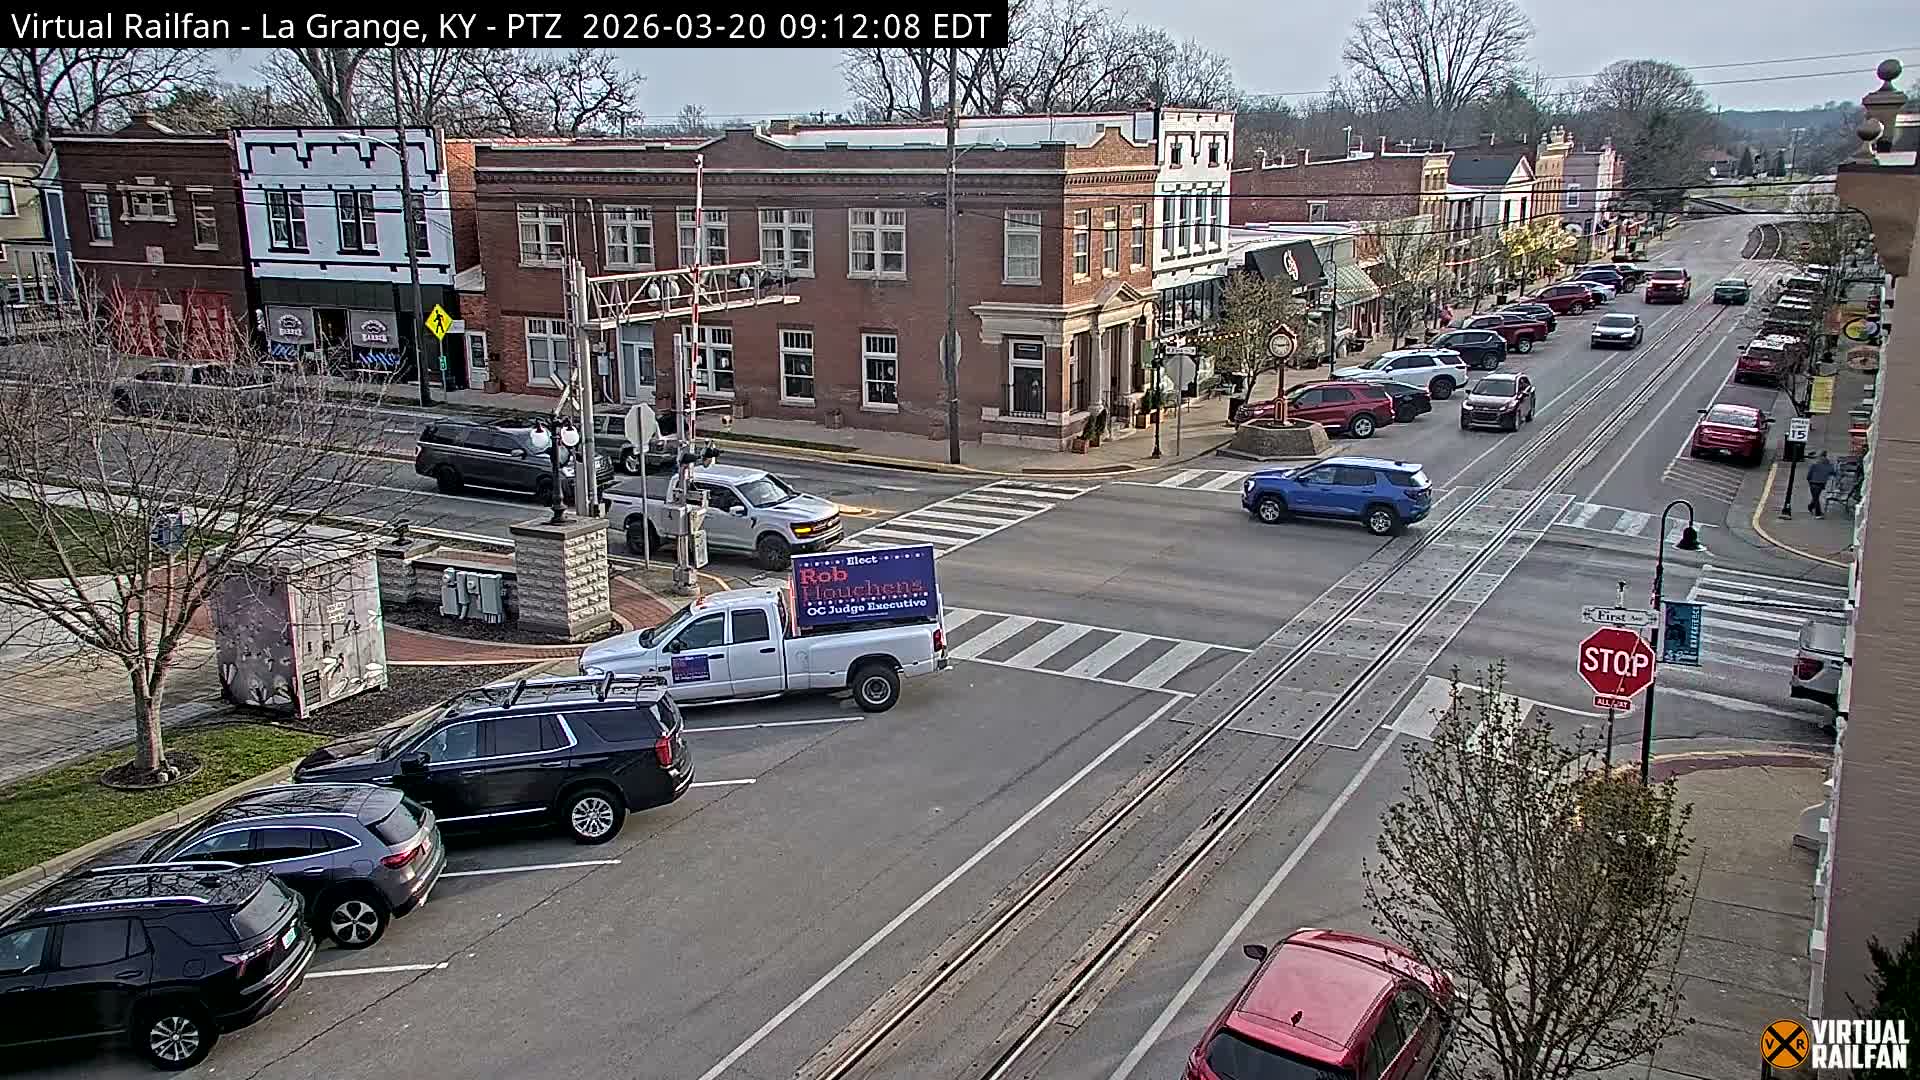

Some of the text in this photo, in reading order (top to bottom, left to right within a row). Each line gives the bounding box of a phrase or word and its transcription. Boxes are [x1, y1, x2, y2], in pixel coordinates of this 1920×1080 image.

[1791, 430, 1806, 440] 15
[846, 554, 879, 566] Elect
[800, 566, 849, 585] Rob
[807, 606, 827, 616] OC
[828, 602, 865, 615] Judge
[867, 599, 927, 611] Executive
[1598, 610, 1626, 623] First
[1583, 646, 1649, 677] STOP
